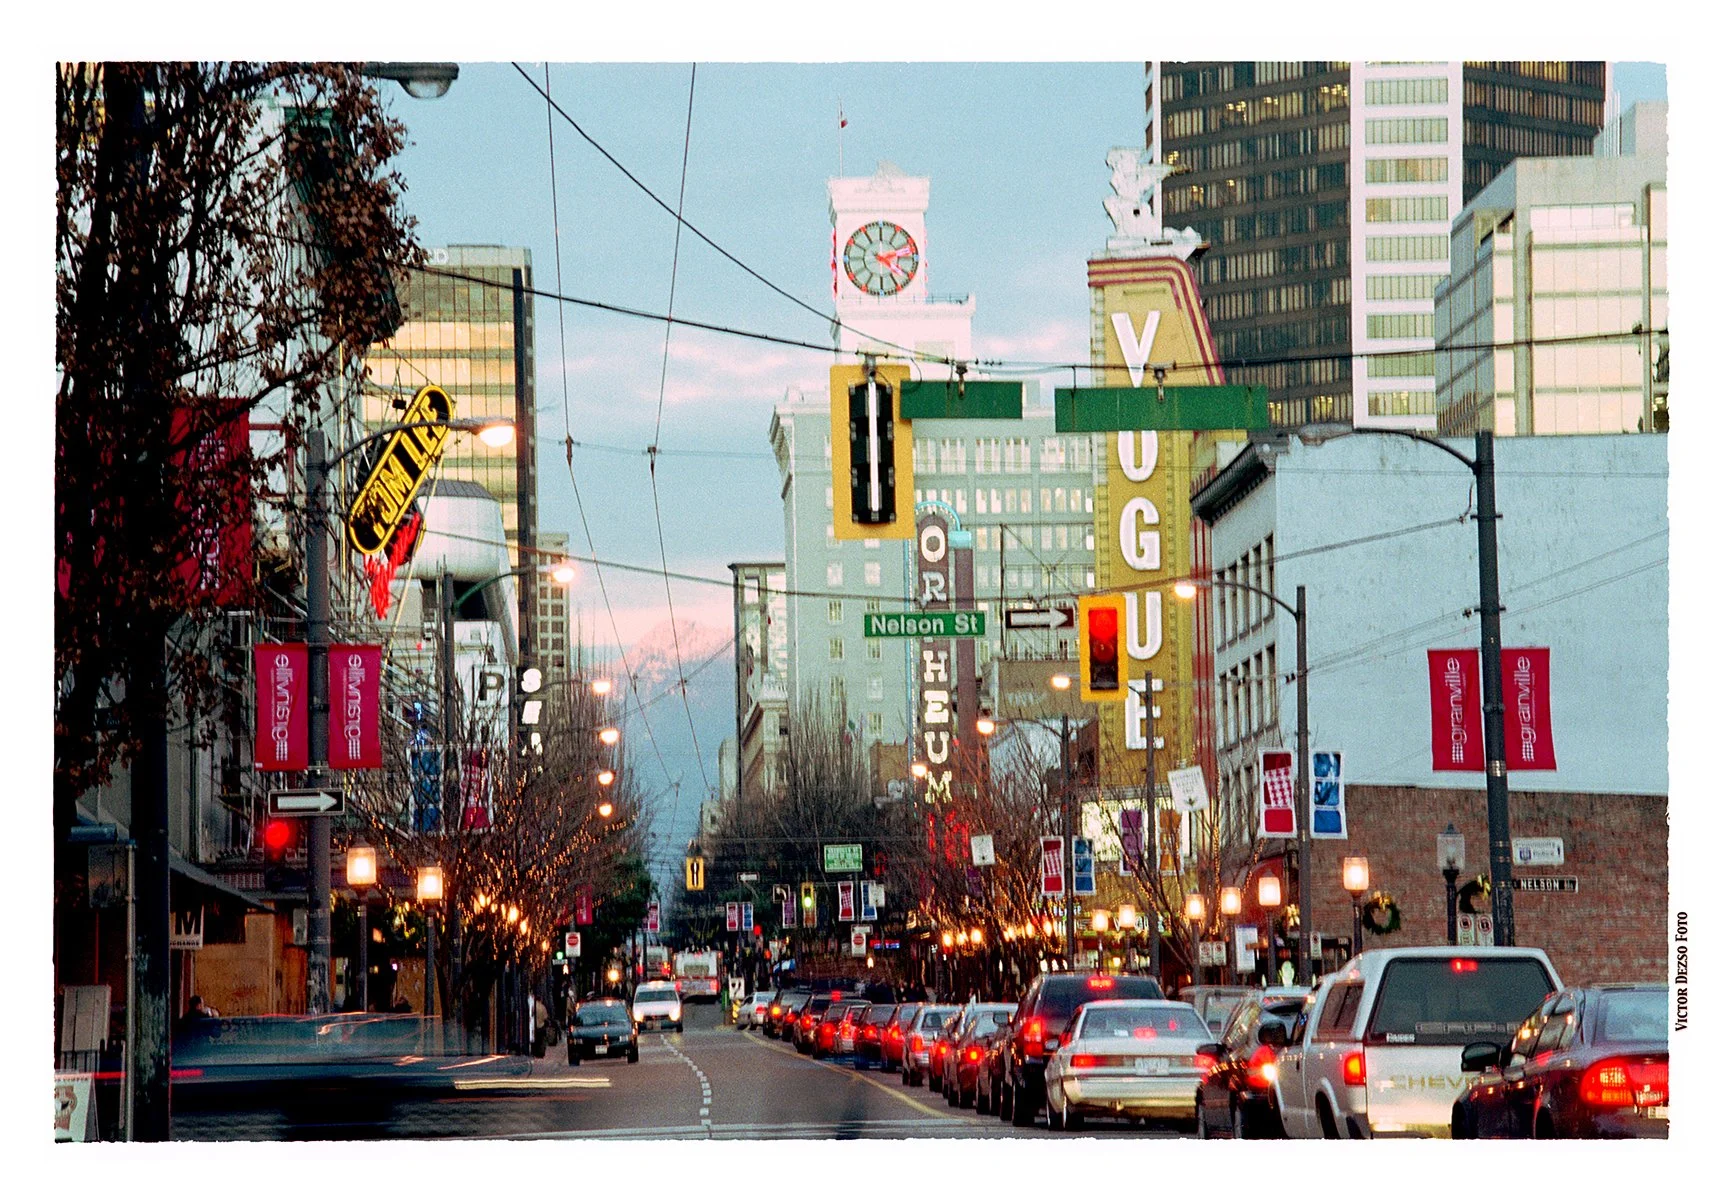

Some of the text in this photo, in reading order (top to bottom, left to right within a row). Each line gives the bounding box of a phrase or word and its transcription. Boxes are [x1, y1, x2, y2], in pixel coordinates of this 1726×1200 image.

[871, 613, 978, 635] Nelson St
[920, 525, 952, 804] ORHEUM
[1444, 657, 1468, 744] granville
[1513, 656, 1537, 744] granville
[1520, 877, 1560, 891] NELSON
